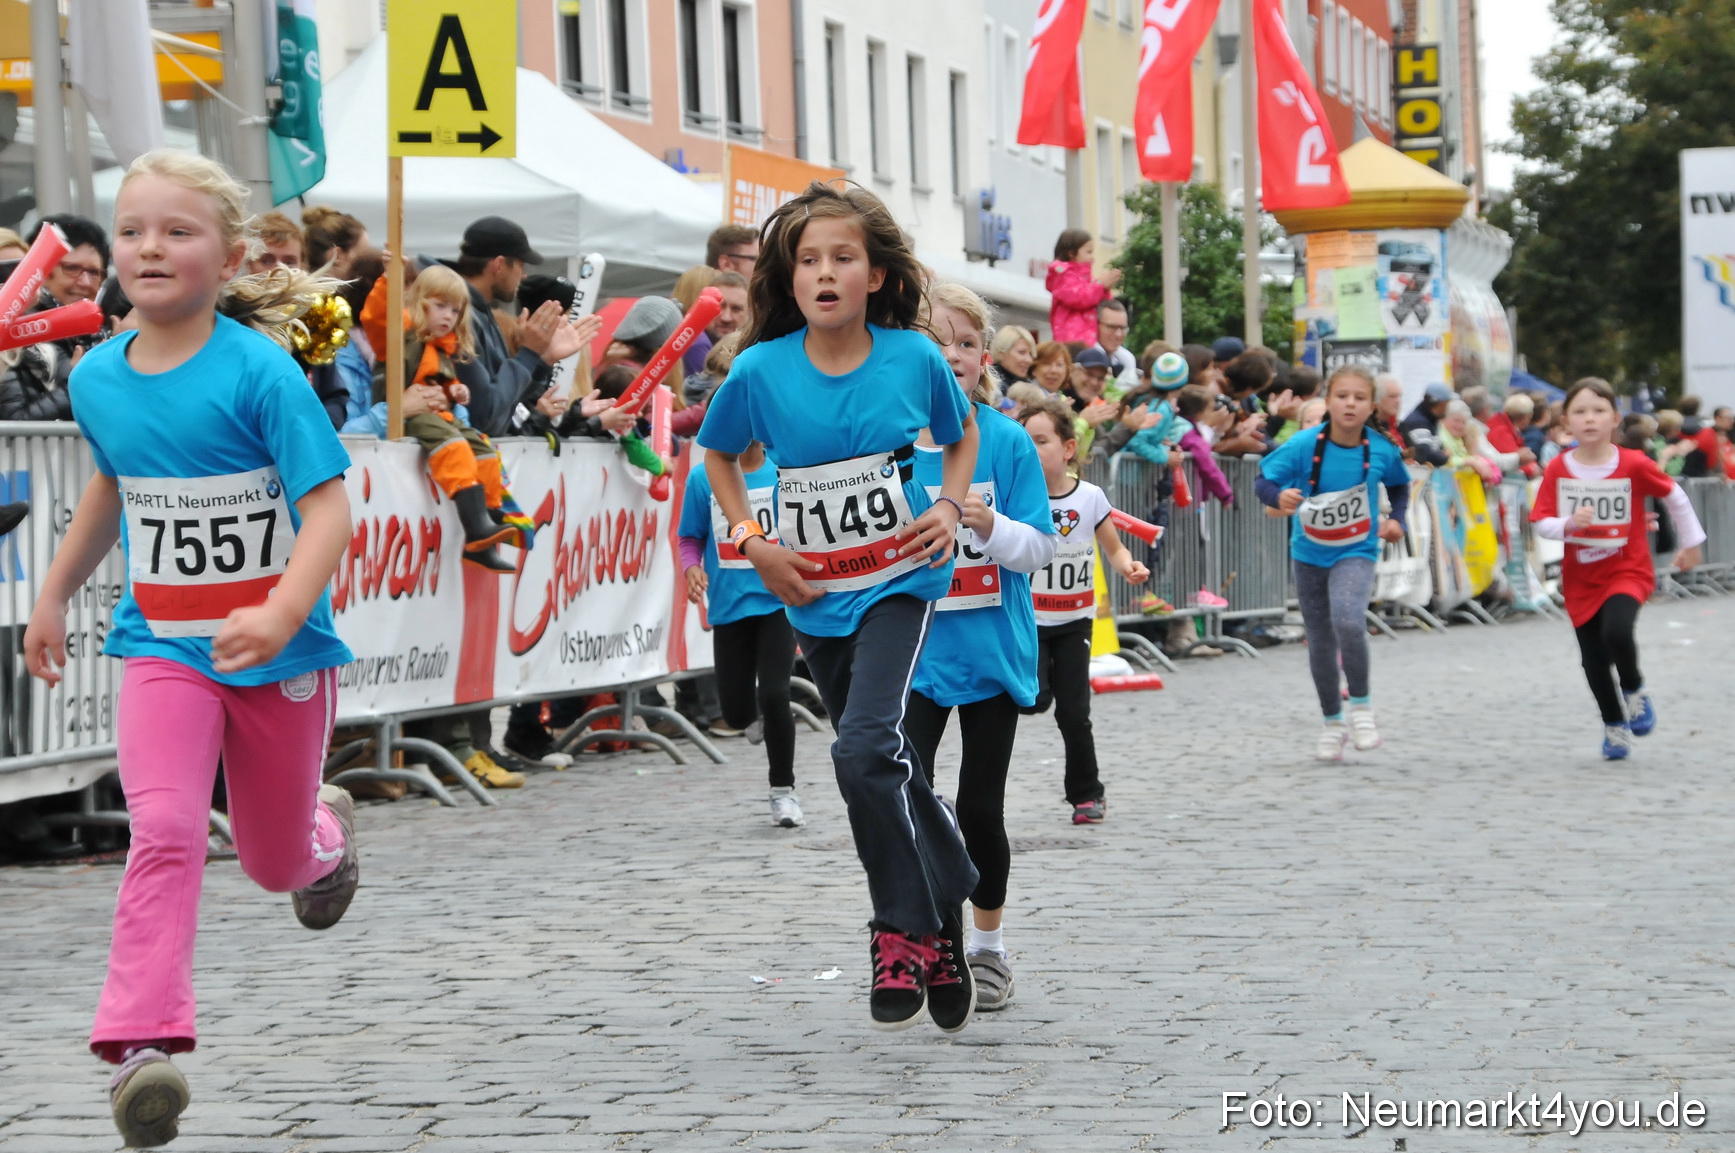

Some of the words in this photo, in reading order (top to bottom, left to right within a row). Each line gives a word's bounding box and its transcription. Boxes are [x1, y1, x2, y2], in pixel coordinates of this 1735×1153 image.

[414, 13, 488, 112] A
[630, 375, 654, 401] Audi
[649, 354, 671, 378] BKK
[126, 491, 175, 509] PARTL
[178, 488, 262, 509] Neumarkt
[809, 472, 877, 493] Neumarkt
[785, 487, 898, 546] 7149
[1308, 497, 1364, 526] 7592
[140, 508, 277, 577] 7557
[827, 550, 878, 575] Leoni
[1037, 597, 1076, 609] Milena
[404, 641, 449, 684] Radio
[560, 631, 632, 666] Ostbayerns
